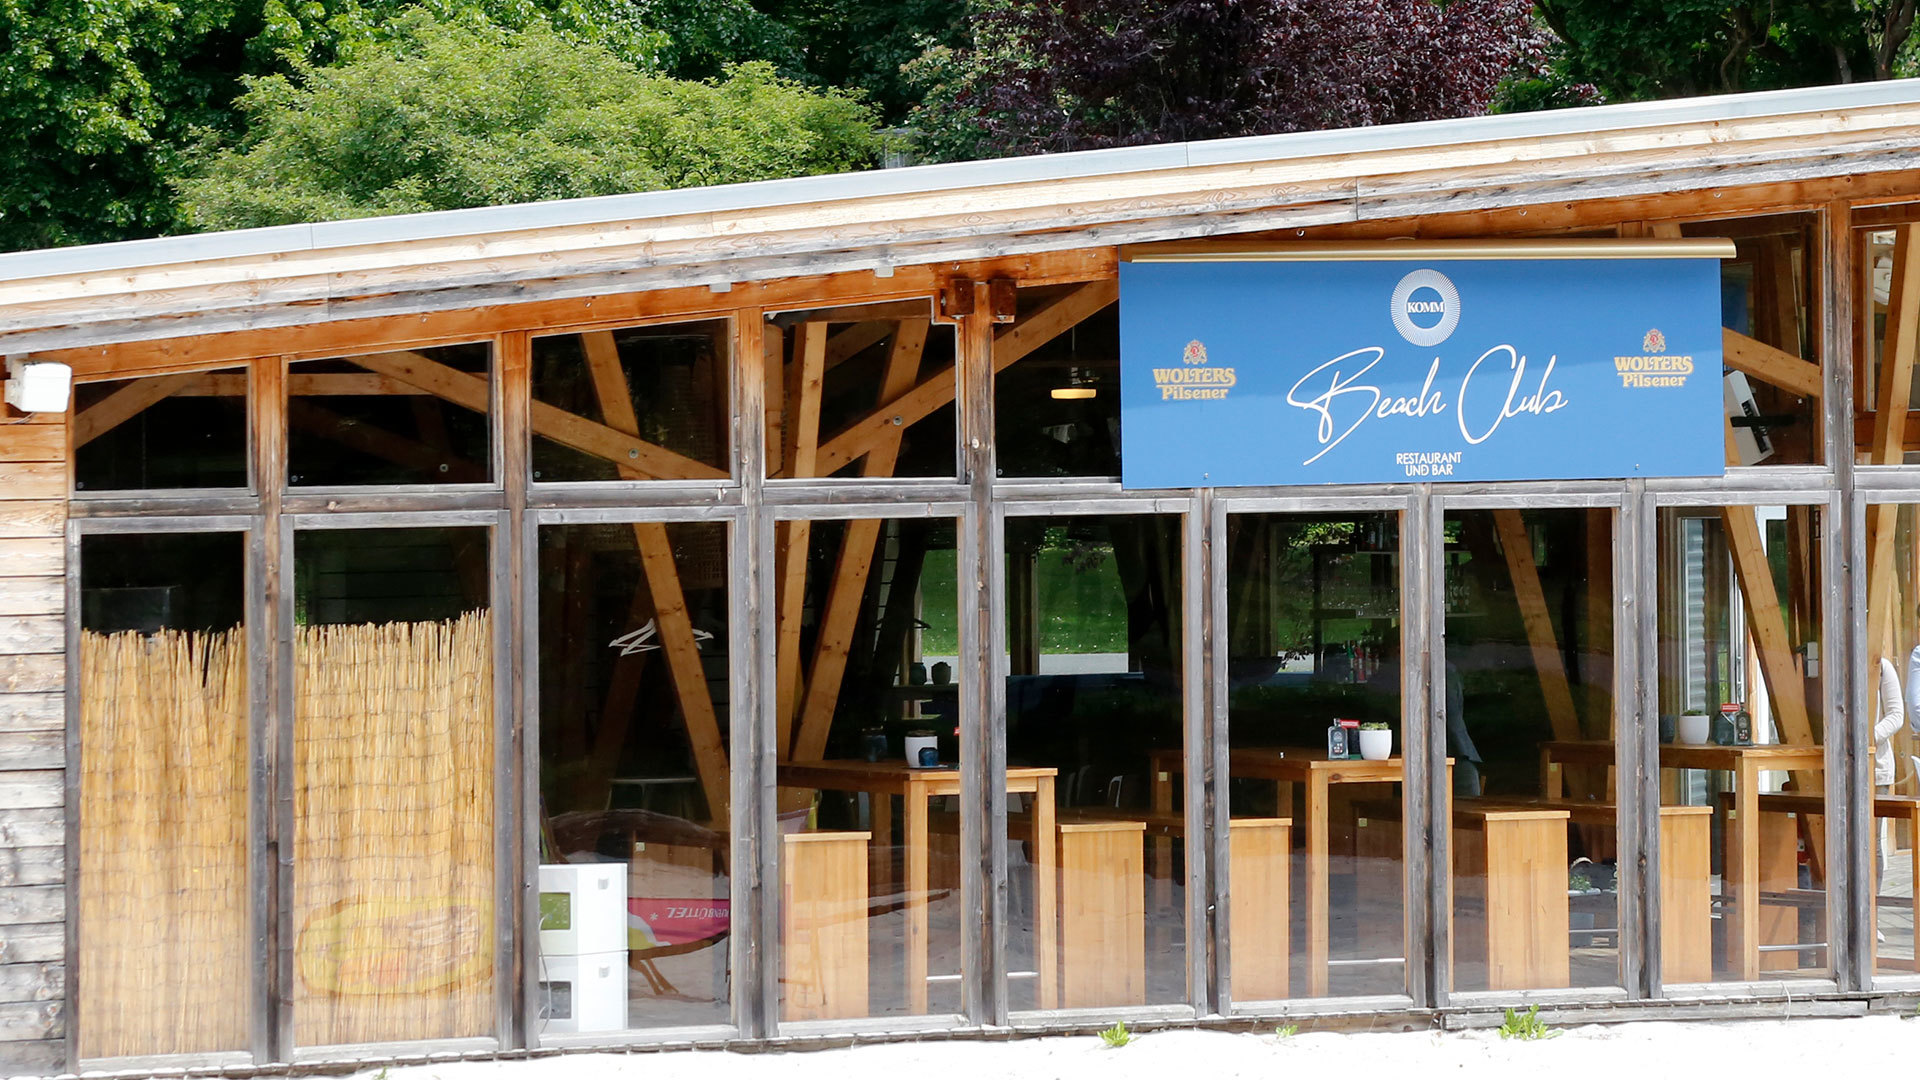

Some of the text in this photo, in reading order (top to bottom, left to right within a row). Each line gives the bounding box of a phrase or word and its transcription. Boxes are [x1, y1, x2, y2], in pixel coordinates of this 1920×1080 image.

[1407, 302, 1444, 313] KOMM
[1614, 356, 1694, 374] WOLTERS
[1152, 368, 1237, 387] WOLTERS
[1622, 373, 1687, 387] Pilsener
[1162, 386, 1229, 400] Pilsener
[1287, 344, 1568, 465] Beach Club
[1396, 452, 1462, 464] RESTAURANT
[1405, 464, 1453, 476] UND BAR
